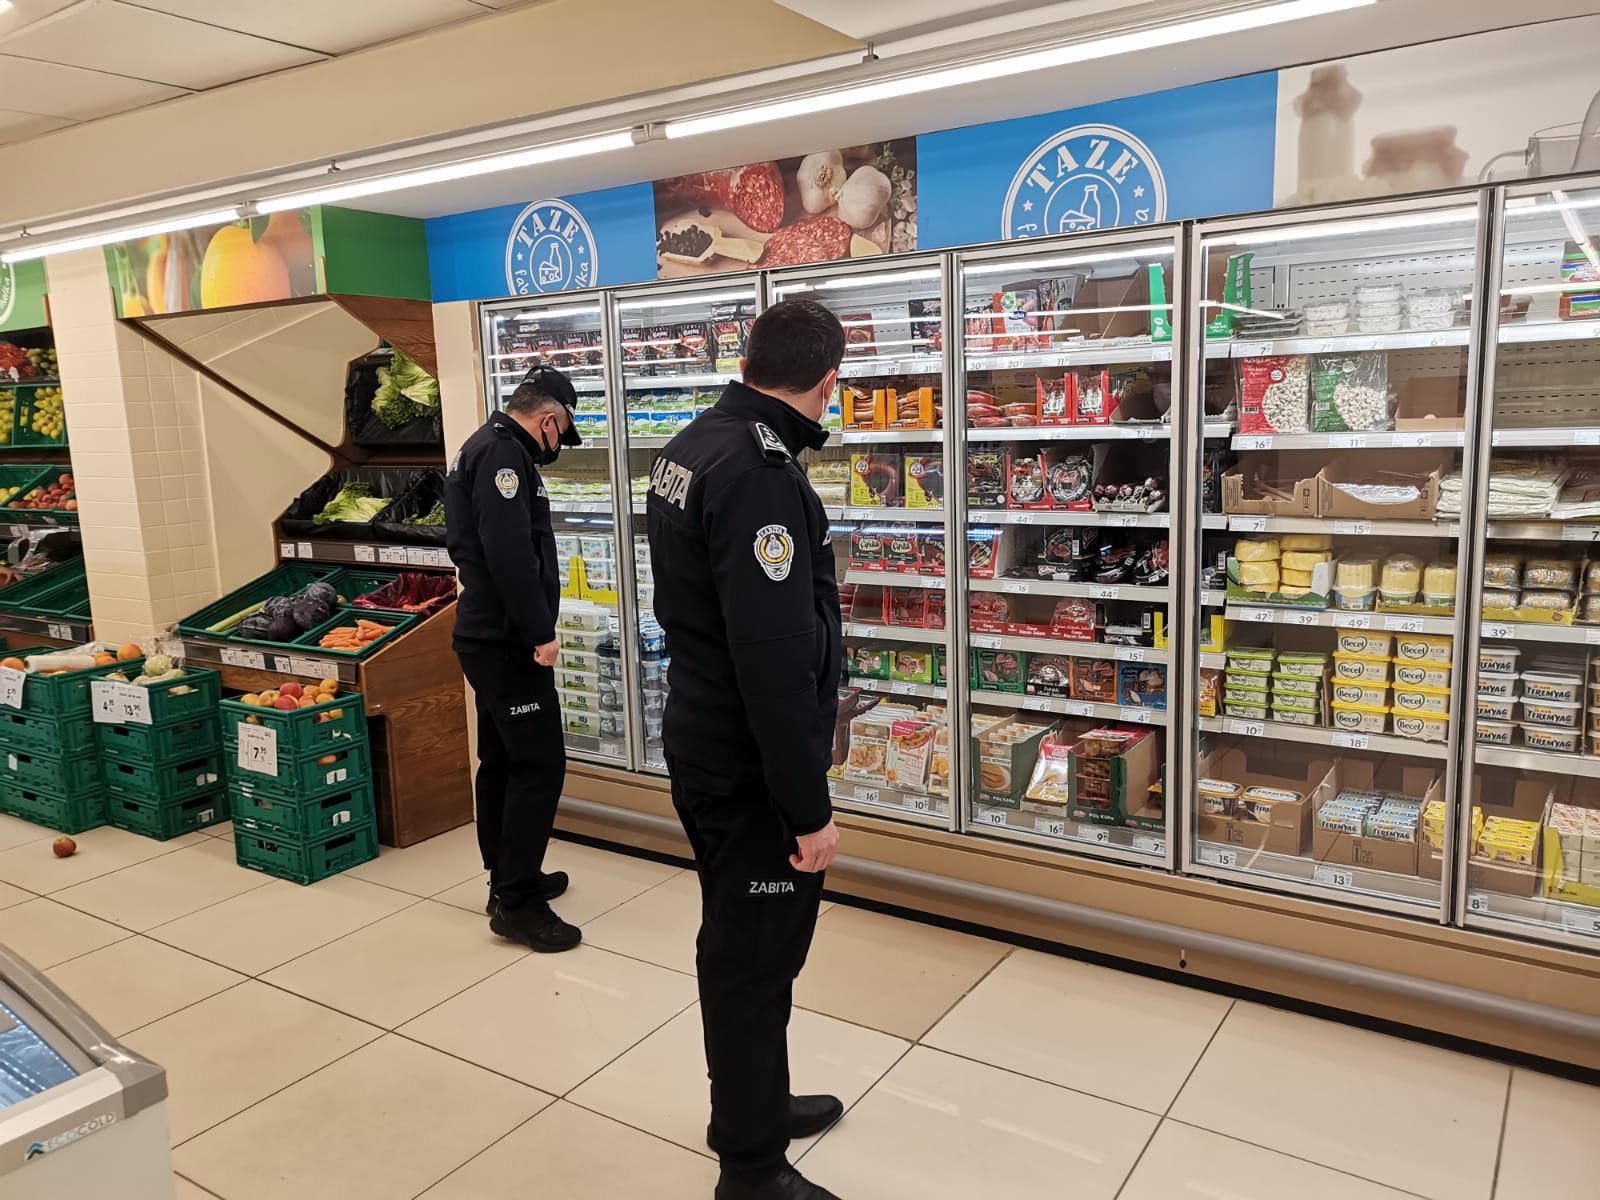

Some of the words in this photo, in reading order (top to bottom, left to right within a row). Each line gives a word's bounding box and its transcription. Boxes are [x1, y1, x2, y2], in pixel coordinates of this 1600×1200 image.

[1026, 139, 1139, 194] TAZE
[516, 208, 580, 249] TAZE
[651, 456, 694, 511] ABITA
[1491, 628, 1507, 637] 39
[1344, 640, 1364, 649] Becel
[1404, 647, 1425, 656] Becel
[1341, 666, 1361, 674] Becel
[1401, 672, 1422, 681] Becel
[1339, 691, 1359, 699] Becel
[1400, 697, 1421, 706] Becel
[509, 702, 541, 716] ZABITA
[1339, 715, 1359, 724] Becel
[1399, 722, 1421, 731] Becel
[253, 746, 259, 760] 7
[866, 792, 874, 801] 16
[915, 800, 924, 810] 10
[991, 814, 1001, 824] 10
[1049, 824, 1059, 835] 16
[1096, 833, 1103, 842] 9
[1153, 843, 1160, 852] 7
[1218, 854, 1230, 865] 15
[1333, 874, 1345, 886] 13
[748, 881, 796, 894] ZABITA
[1471, 898, 1480, 910] 8
